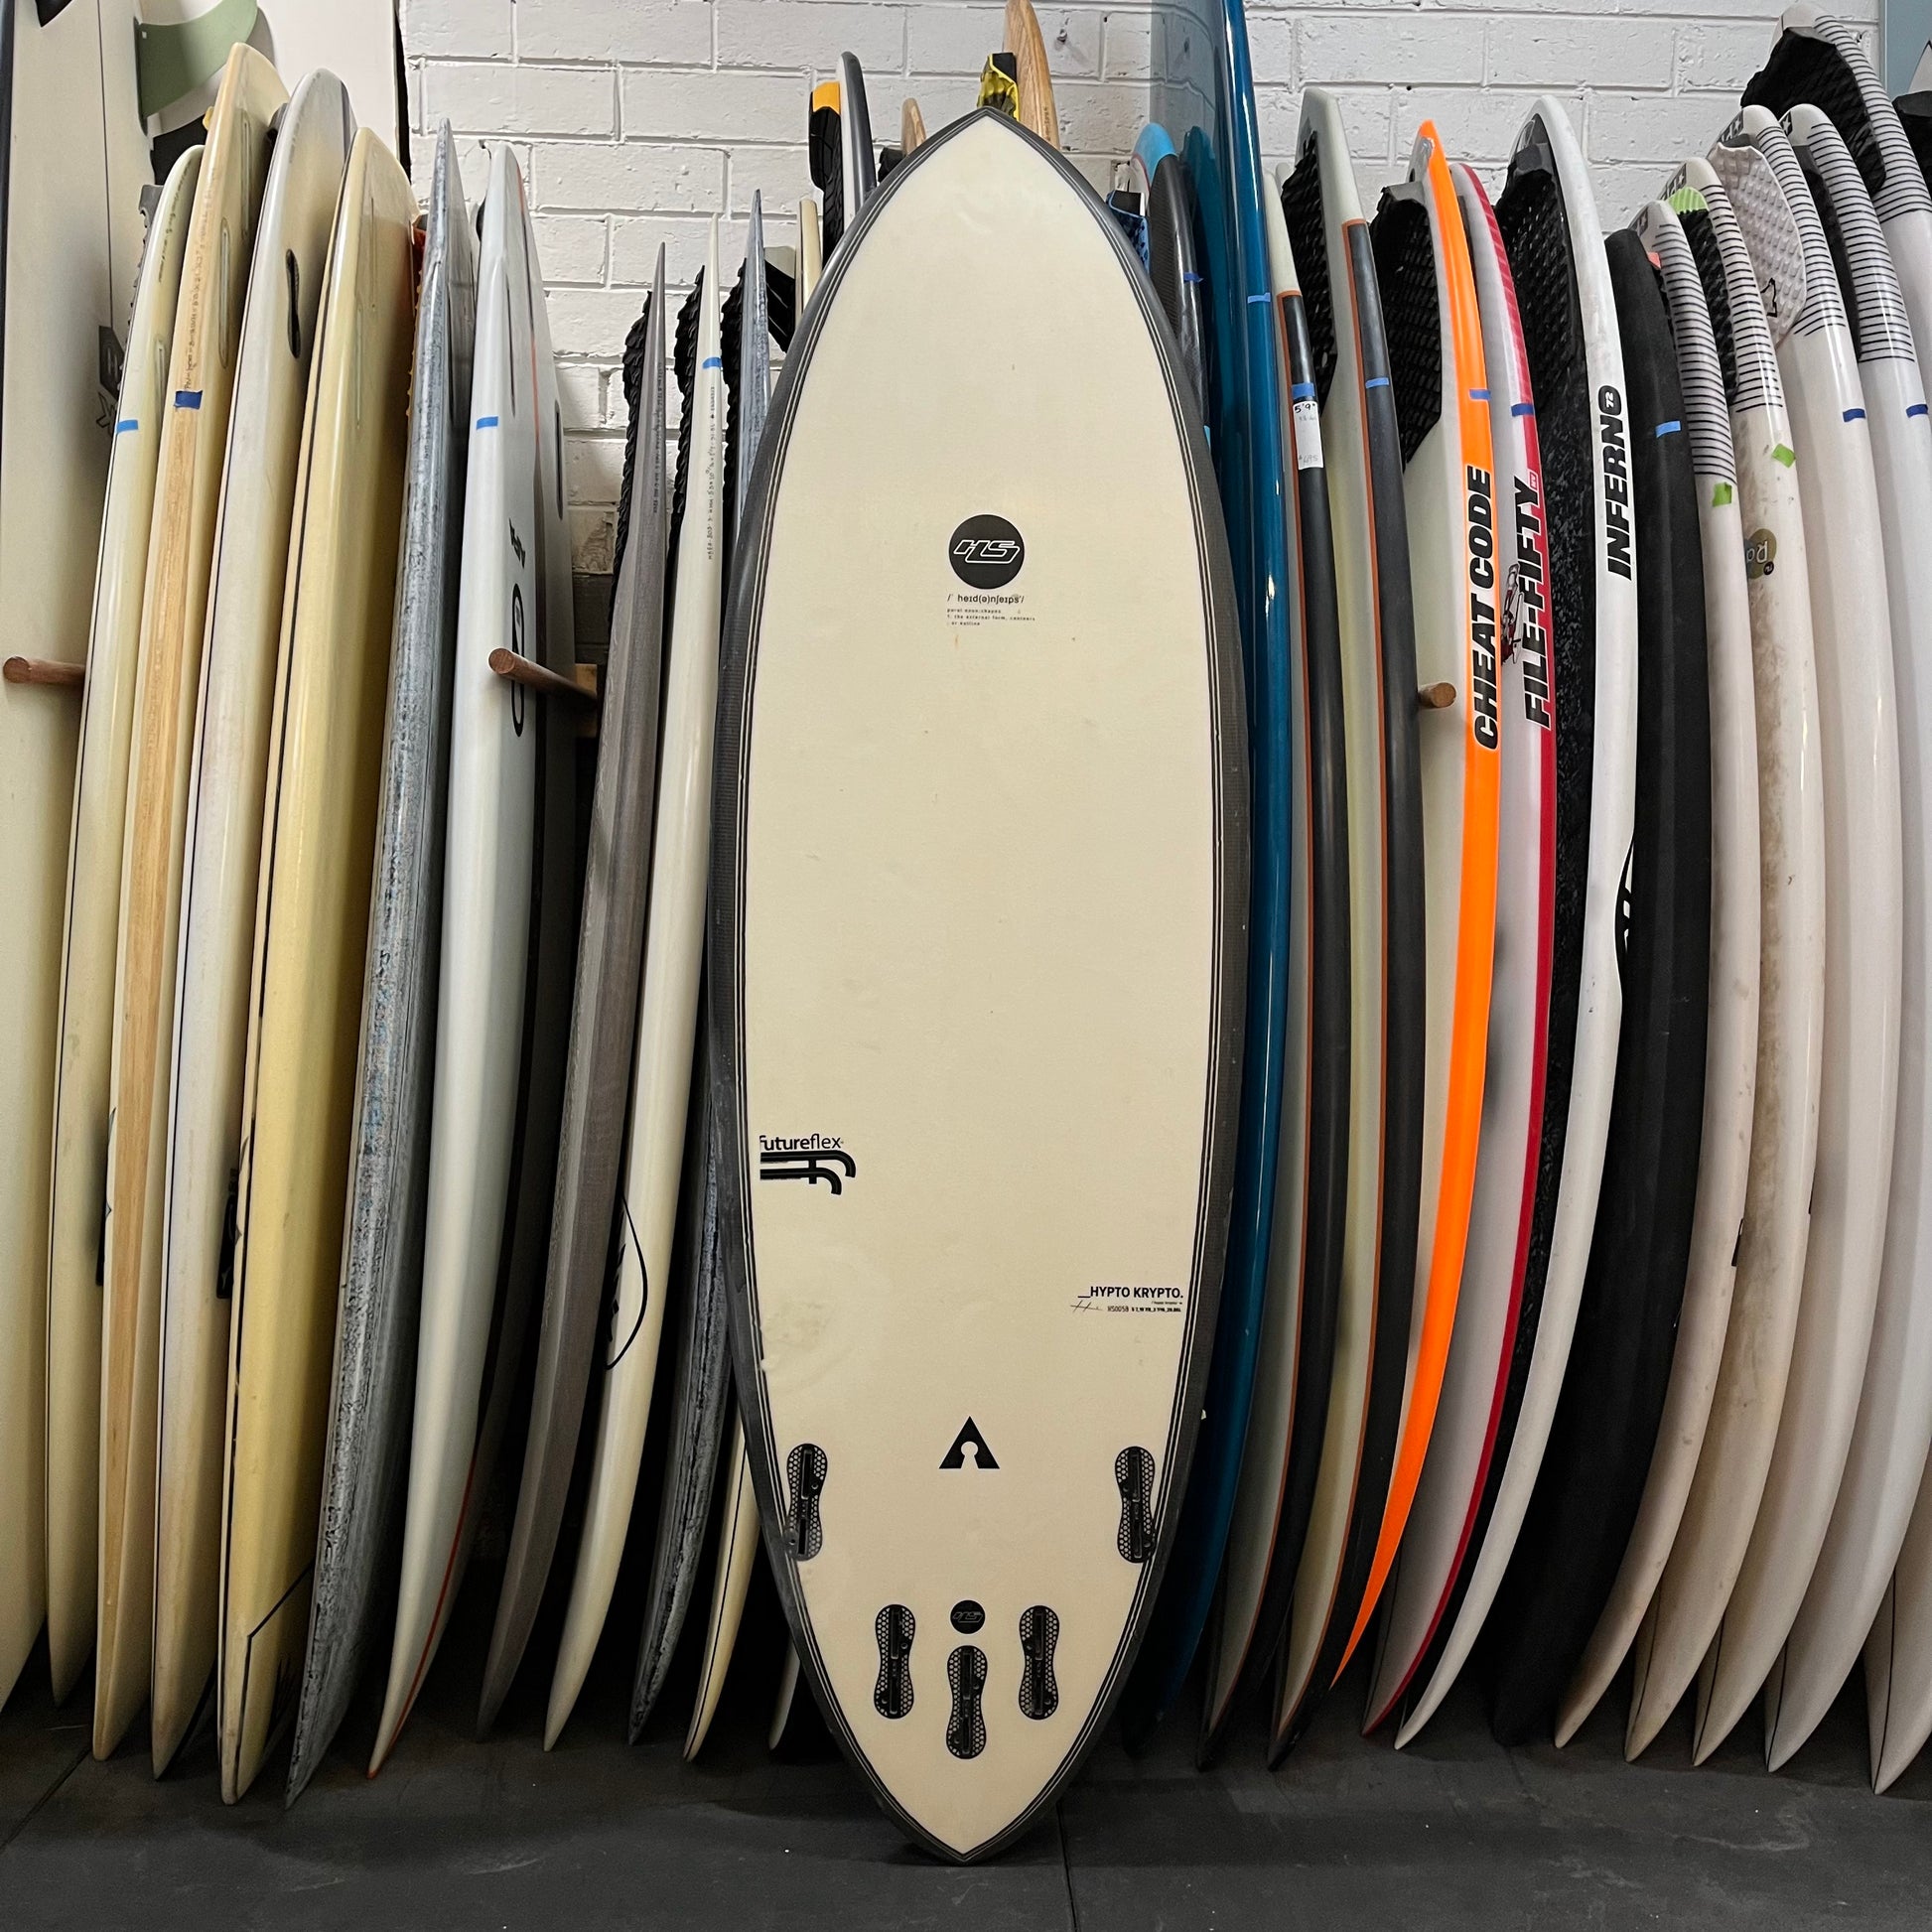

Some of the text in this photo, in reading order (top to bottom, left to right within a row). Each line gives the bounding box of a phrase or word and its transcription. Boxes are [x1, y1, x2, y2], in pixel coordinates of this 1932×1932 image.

[1467, 465, 1498, 751] CHEAT CODE
[1514, 475, 1551, 730] FILE-FIFTY
[1597, 384, 1632, 581] INFERNO
